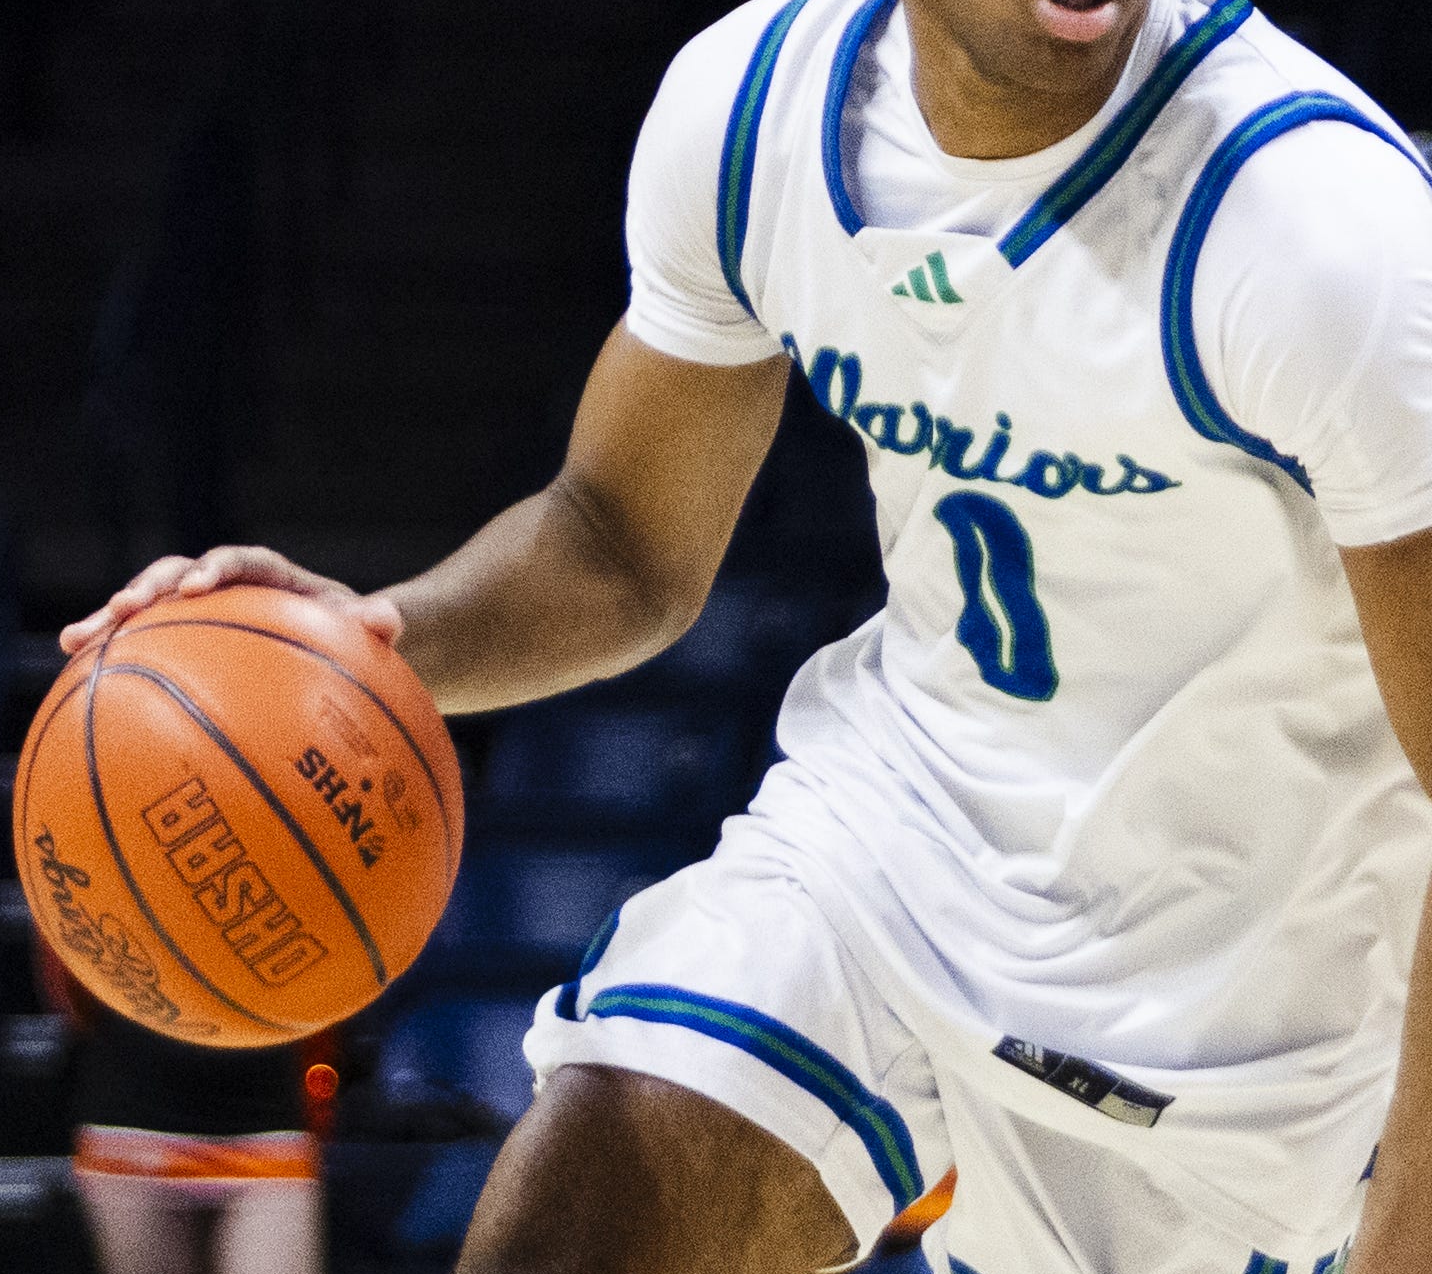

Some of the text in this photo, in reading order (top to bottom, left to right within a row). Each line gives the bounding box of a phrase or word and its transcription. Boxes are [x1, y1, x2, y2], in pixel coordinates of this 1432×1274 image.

[933, 489, 1059, 701] 0
[141, 777, 329, 989] OHSAA
[295, 745, 374, 844] NFHS
